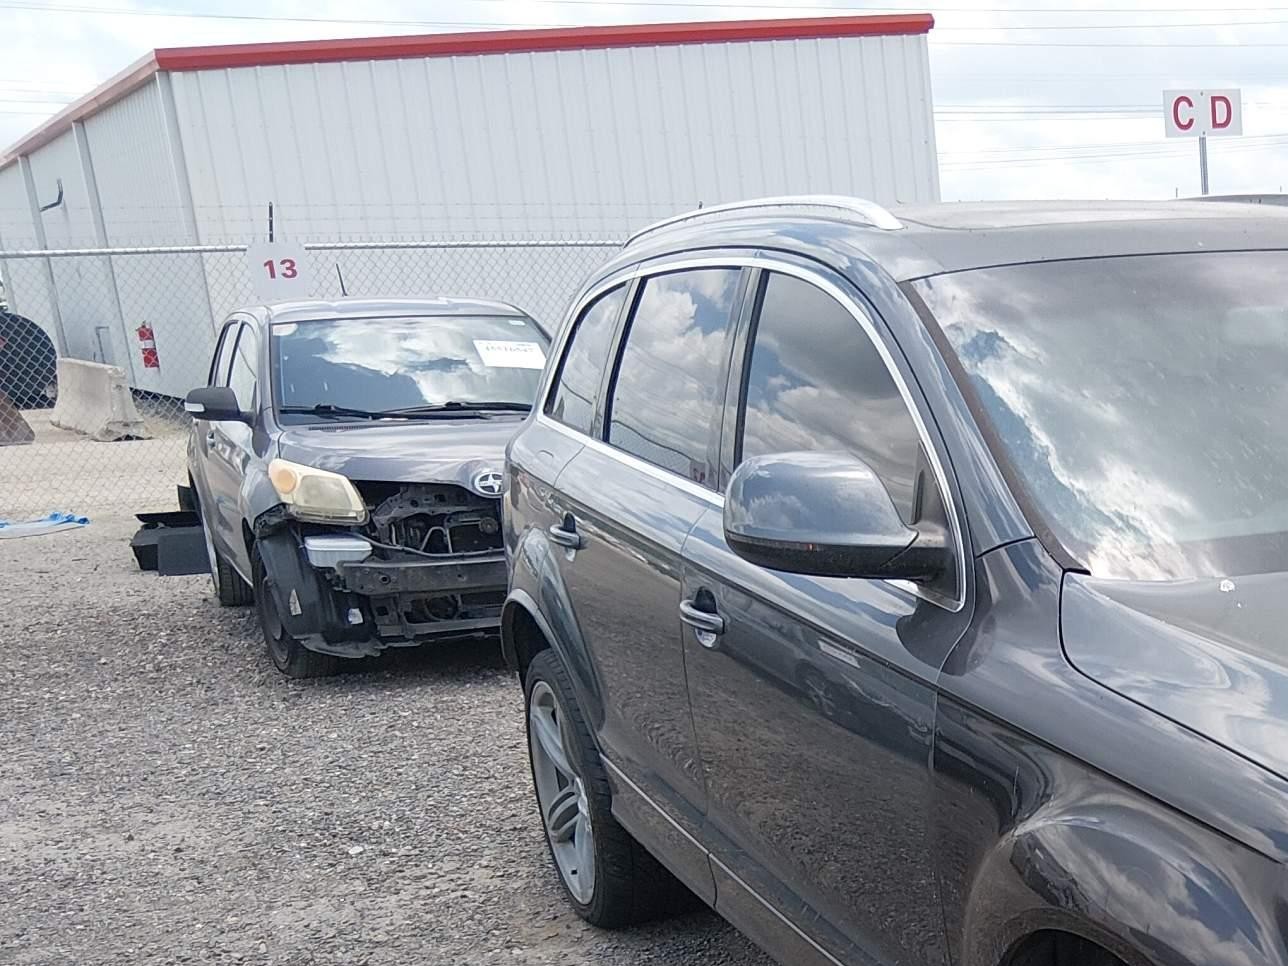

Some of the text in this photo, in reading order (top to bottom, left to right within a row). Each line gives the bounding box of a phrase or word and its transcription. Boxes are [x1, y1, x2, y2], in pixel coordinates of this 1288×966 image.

[1173, 95, 1232, 131] C D
[263, 258, 298, 280] 13
